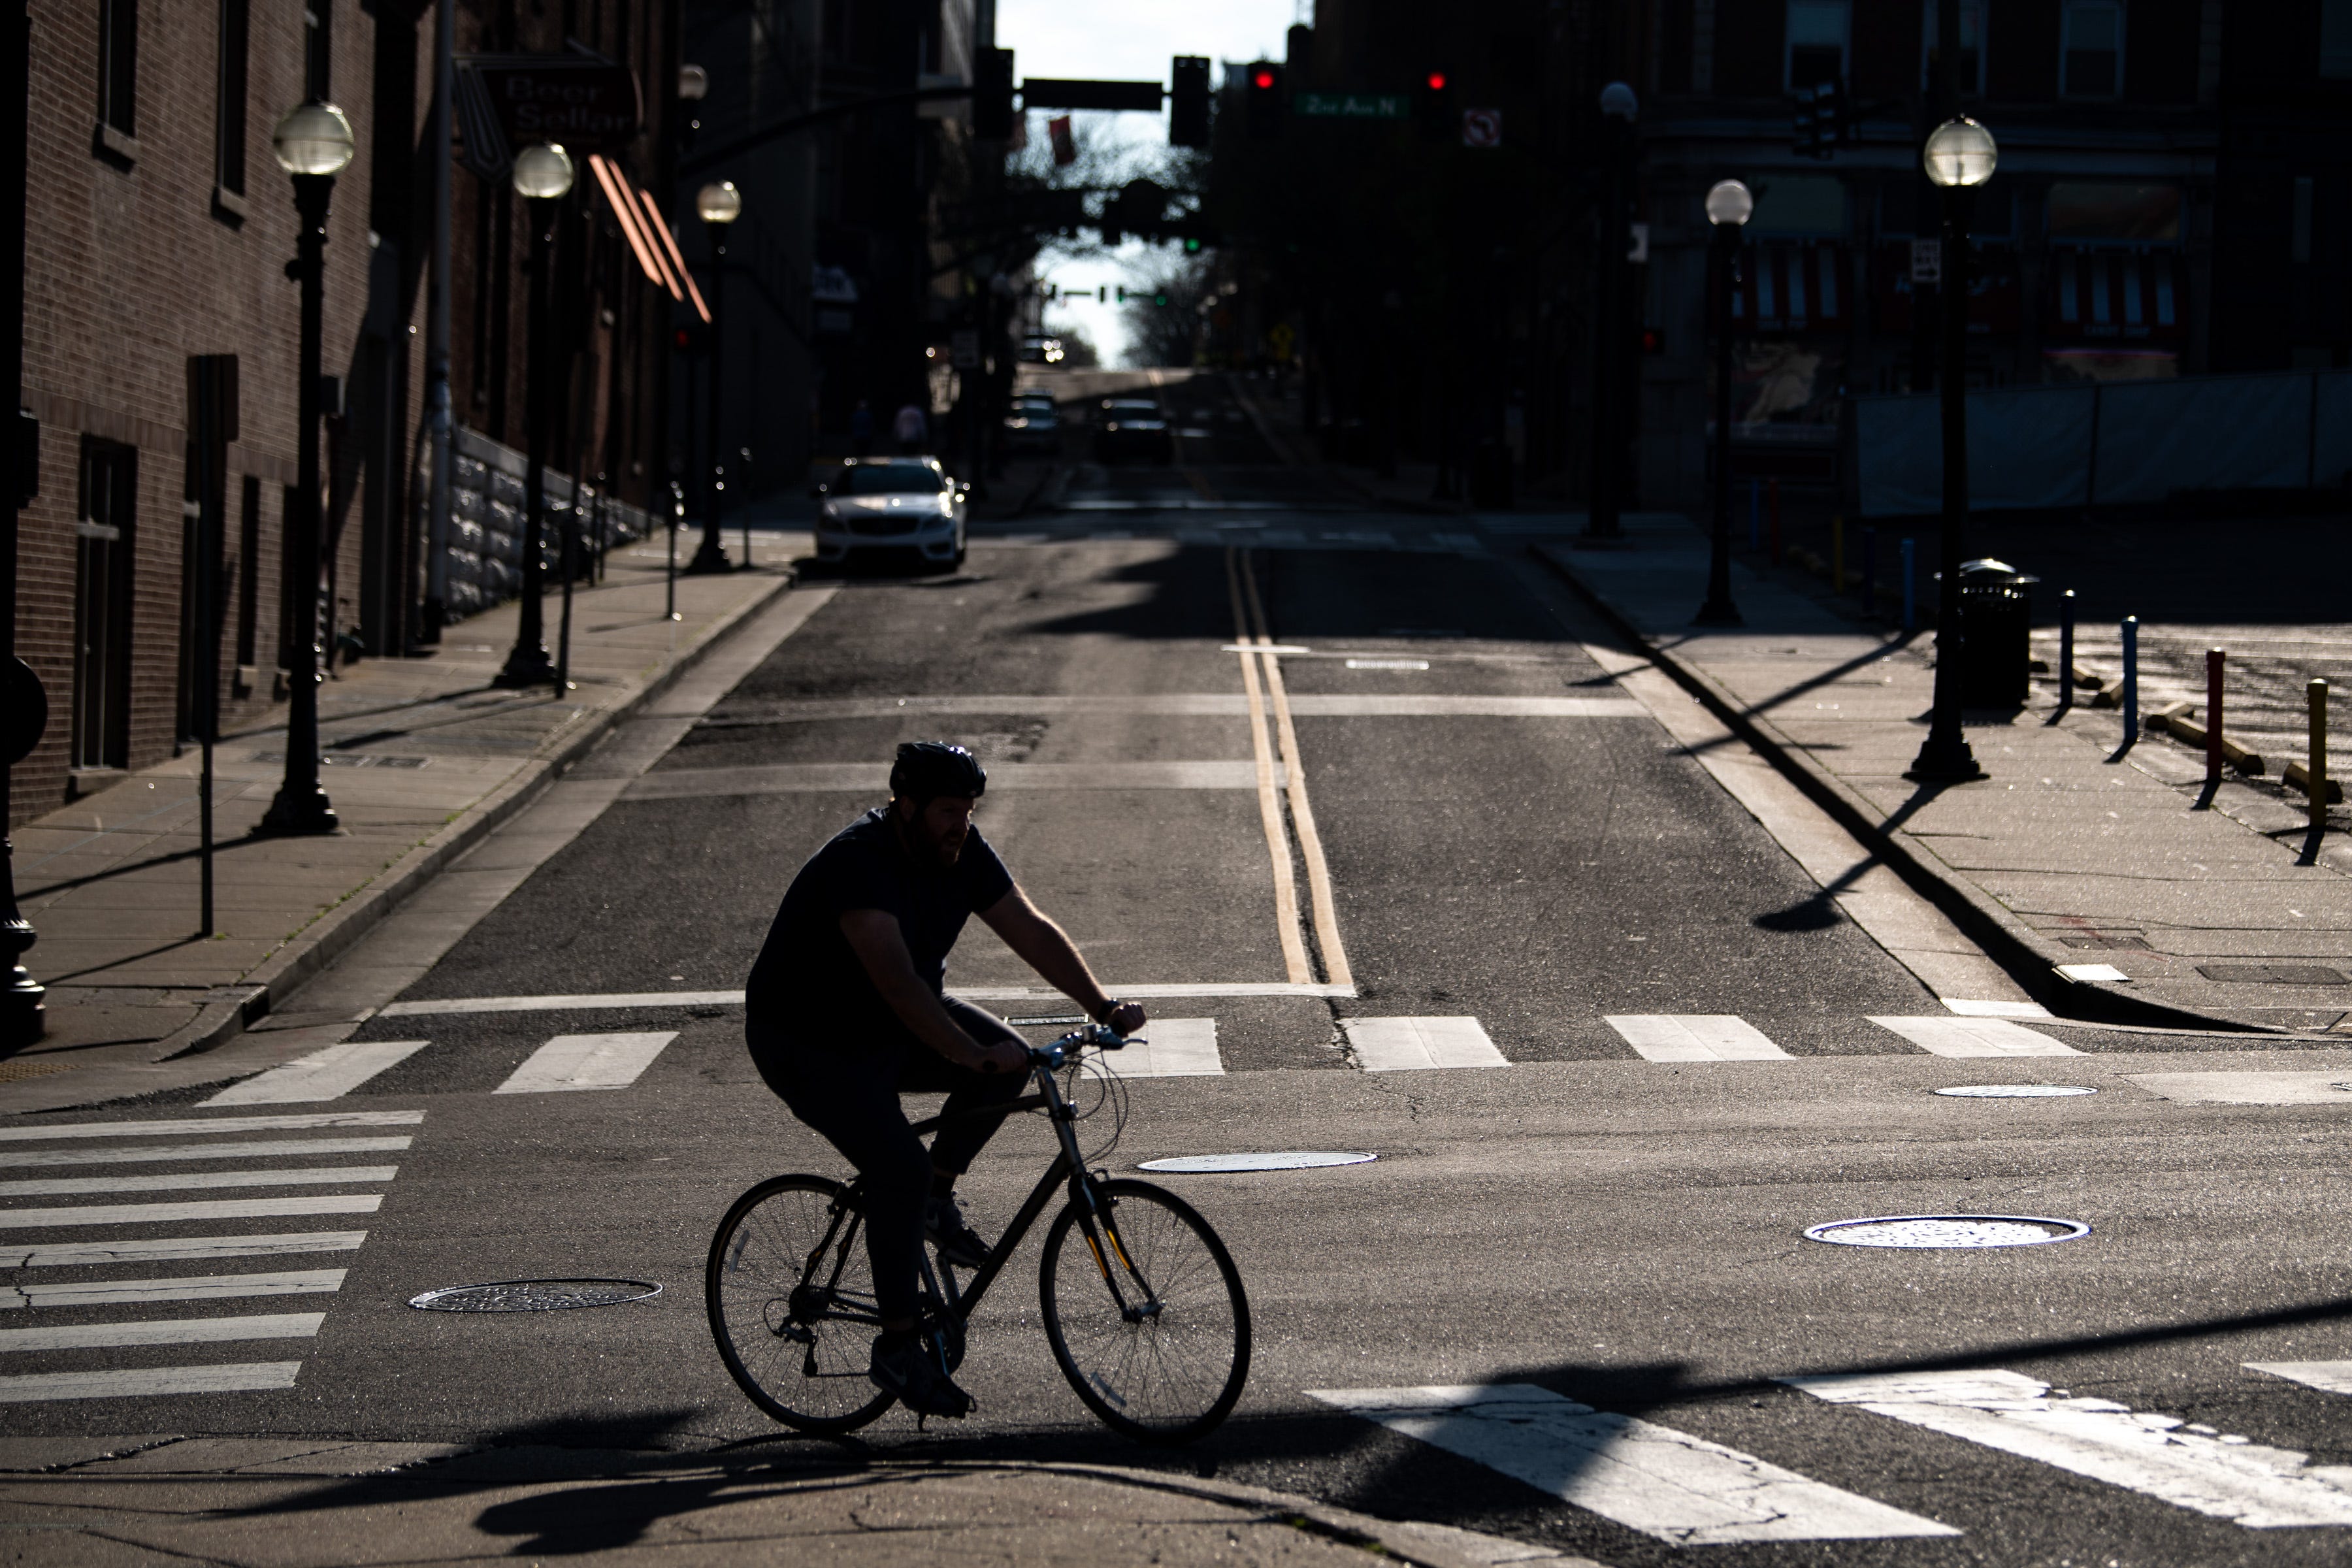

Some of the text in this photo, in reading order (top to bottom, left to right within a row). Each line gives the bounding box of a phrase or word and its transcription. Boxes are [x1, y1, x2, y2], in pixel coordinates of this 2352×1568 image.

[505, 74, 606, 105] Beer
[512, 102, 632, 133] Sellar
[1378, 95, 1397, 116] N
[1916, 255, 1940, 265] WAY
